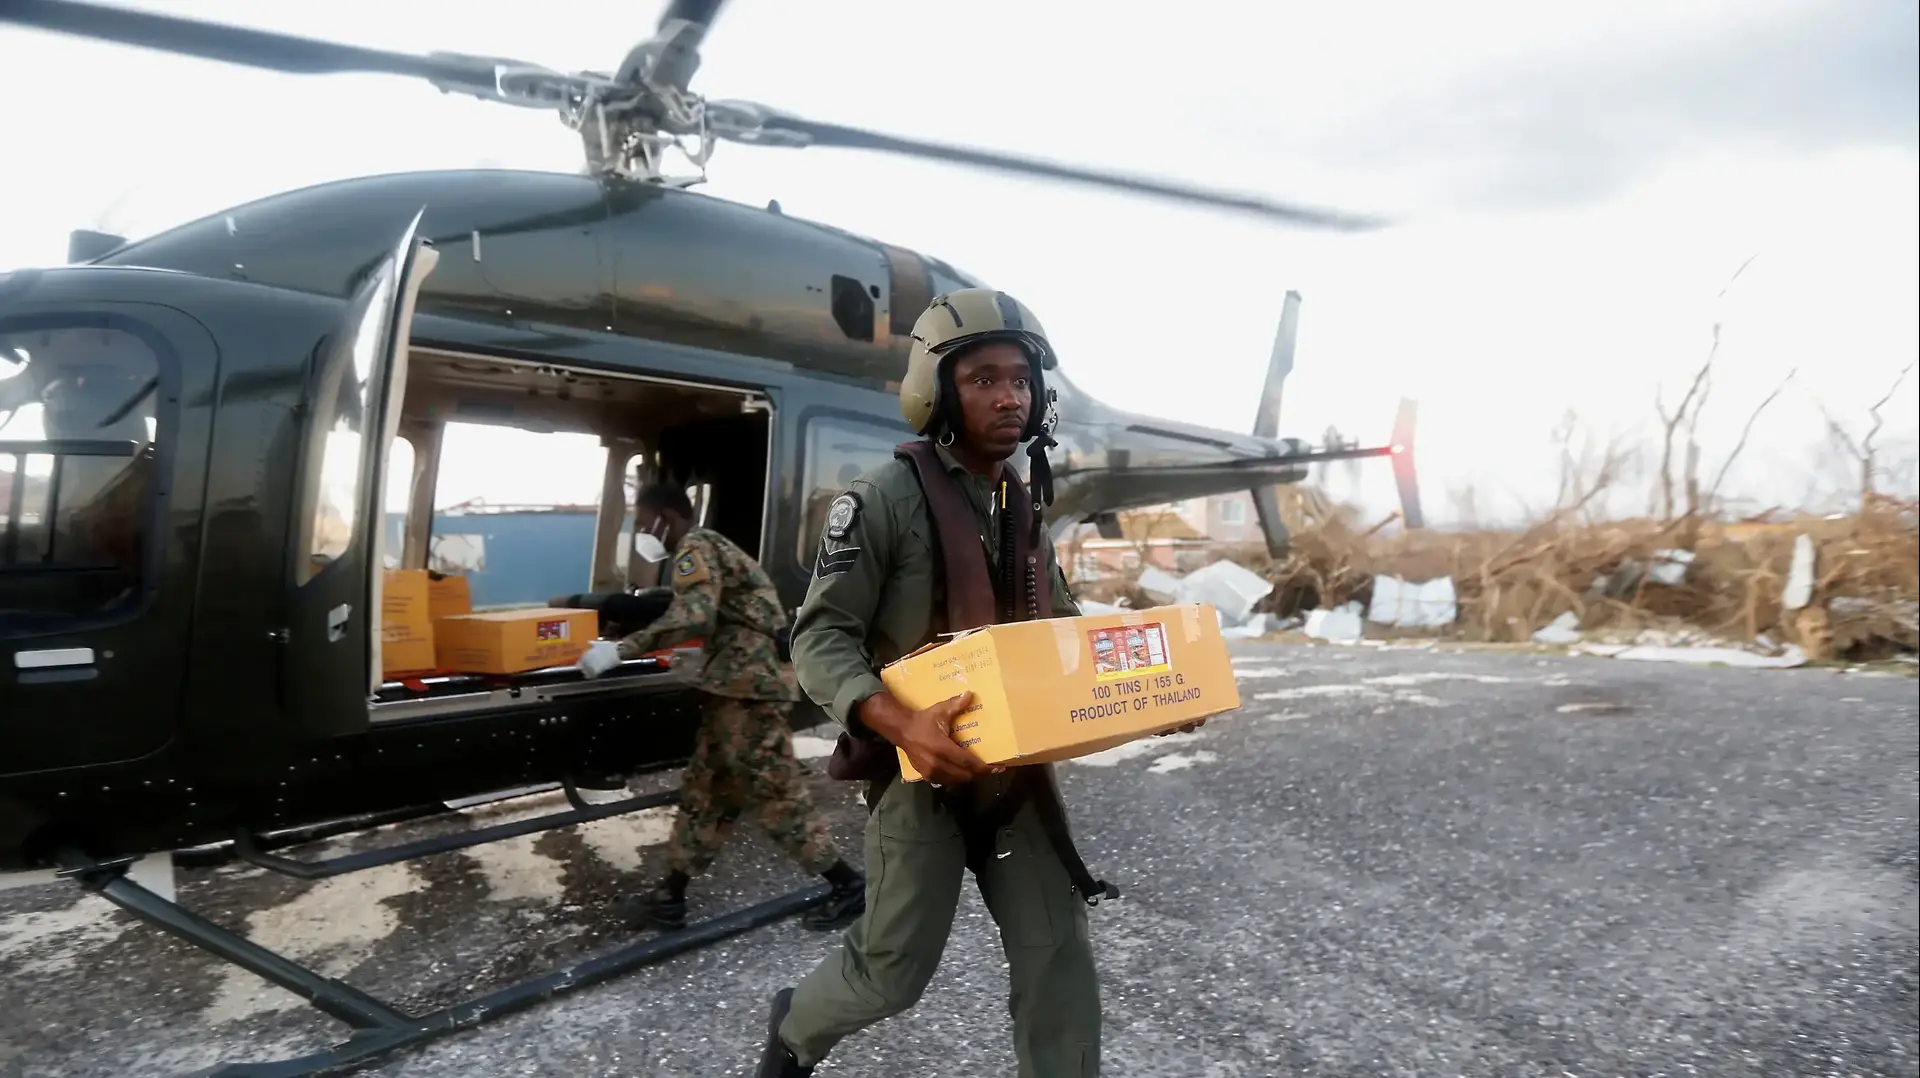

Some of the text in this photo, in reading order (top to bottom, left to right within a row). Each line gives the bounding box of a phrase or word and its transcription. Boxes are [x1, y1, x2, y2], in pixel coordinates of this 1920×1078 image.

[1092, 685, 1111, 700] 100
[1115, 680, 1142, 696] TINS
[1146, 678, 1149, 691] /
[1154, 675, 1172, 689] 155
[1070, 687, 1201, 723] PRODUCT OF THAILAND
[956, 721, 979, 732] Jamaica
